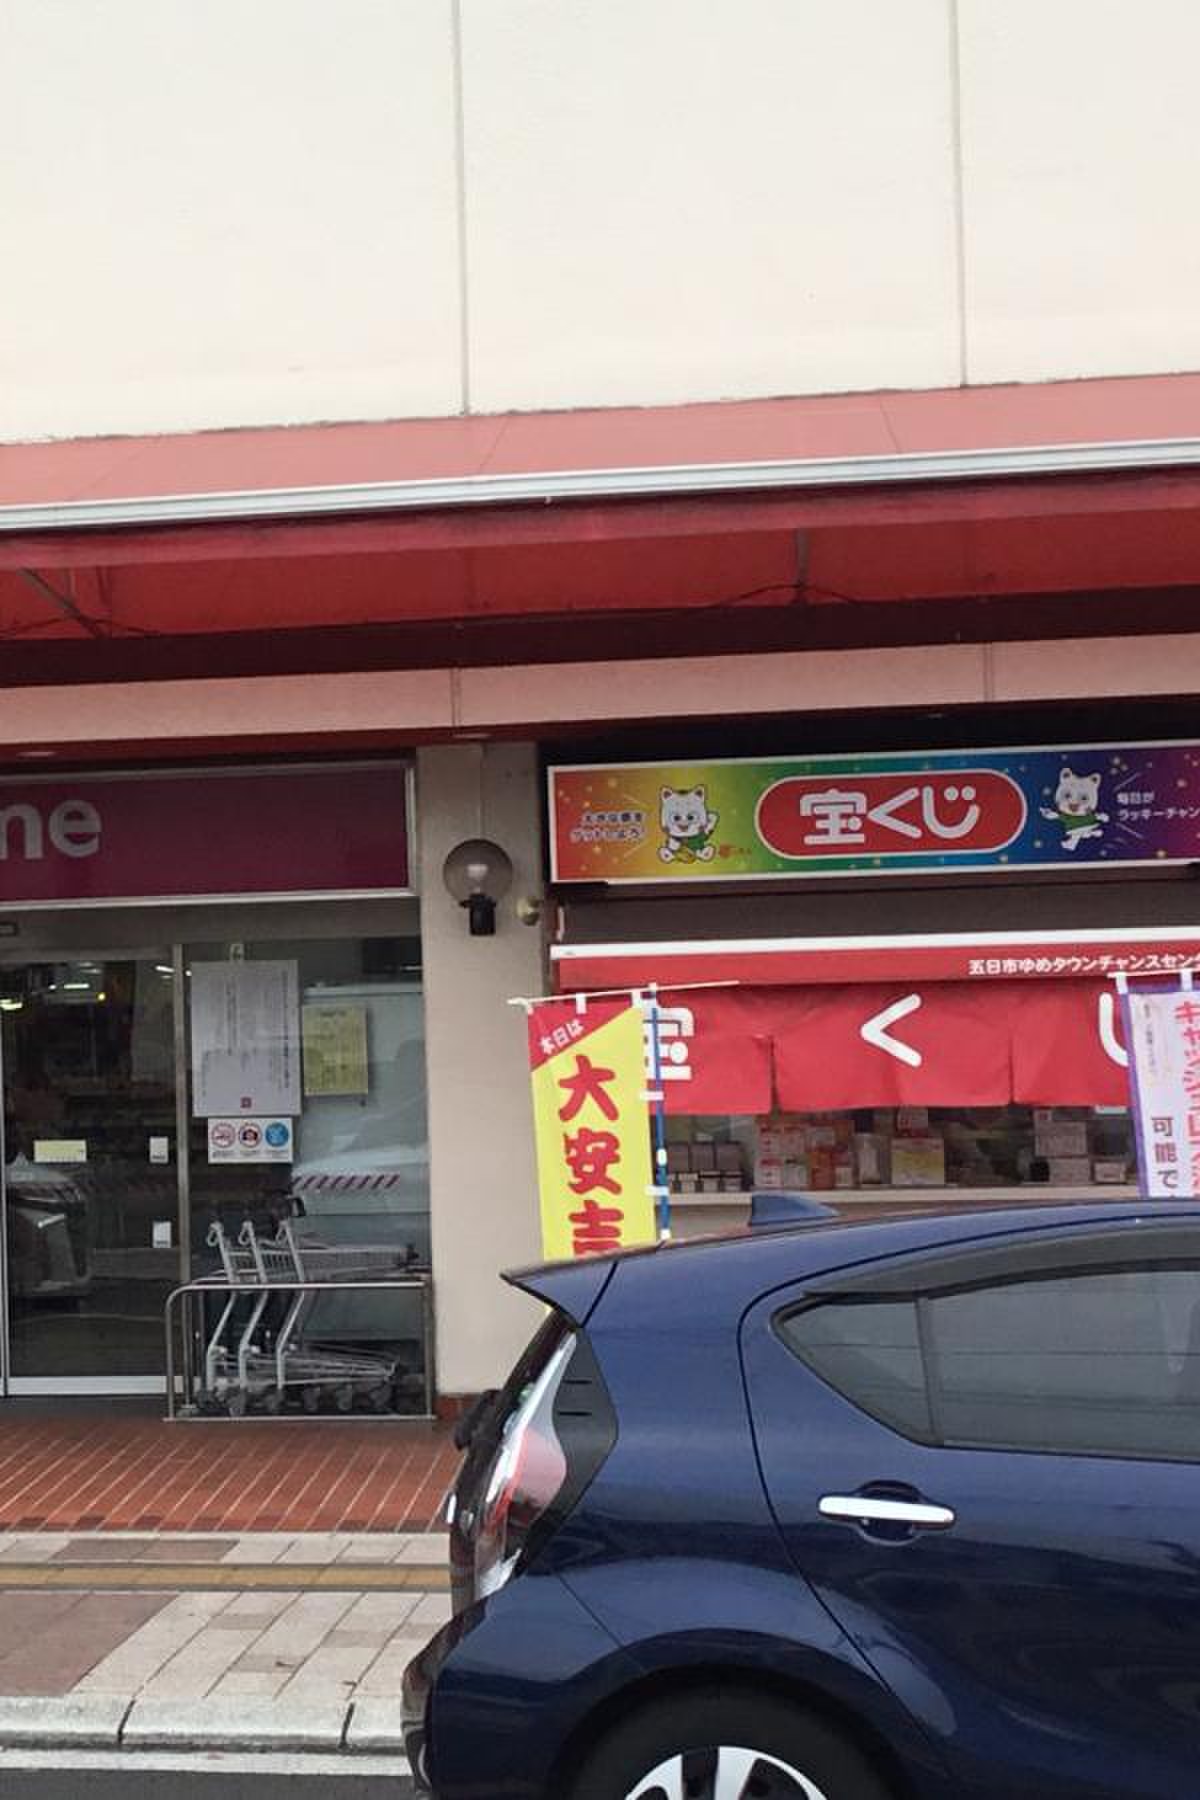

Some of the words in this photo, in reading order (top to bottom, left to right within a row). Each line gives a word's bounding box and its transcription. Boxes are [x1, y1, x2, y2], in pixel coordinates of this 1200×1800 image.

[800, 785, 981, 846] 宝くじ
[539, 1018, 586, 1055] 本日は
[1152, 1118, 1178, 1189] 可能で
